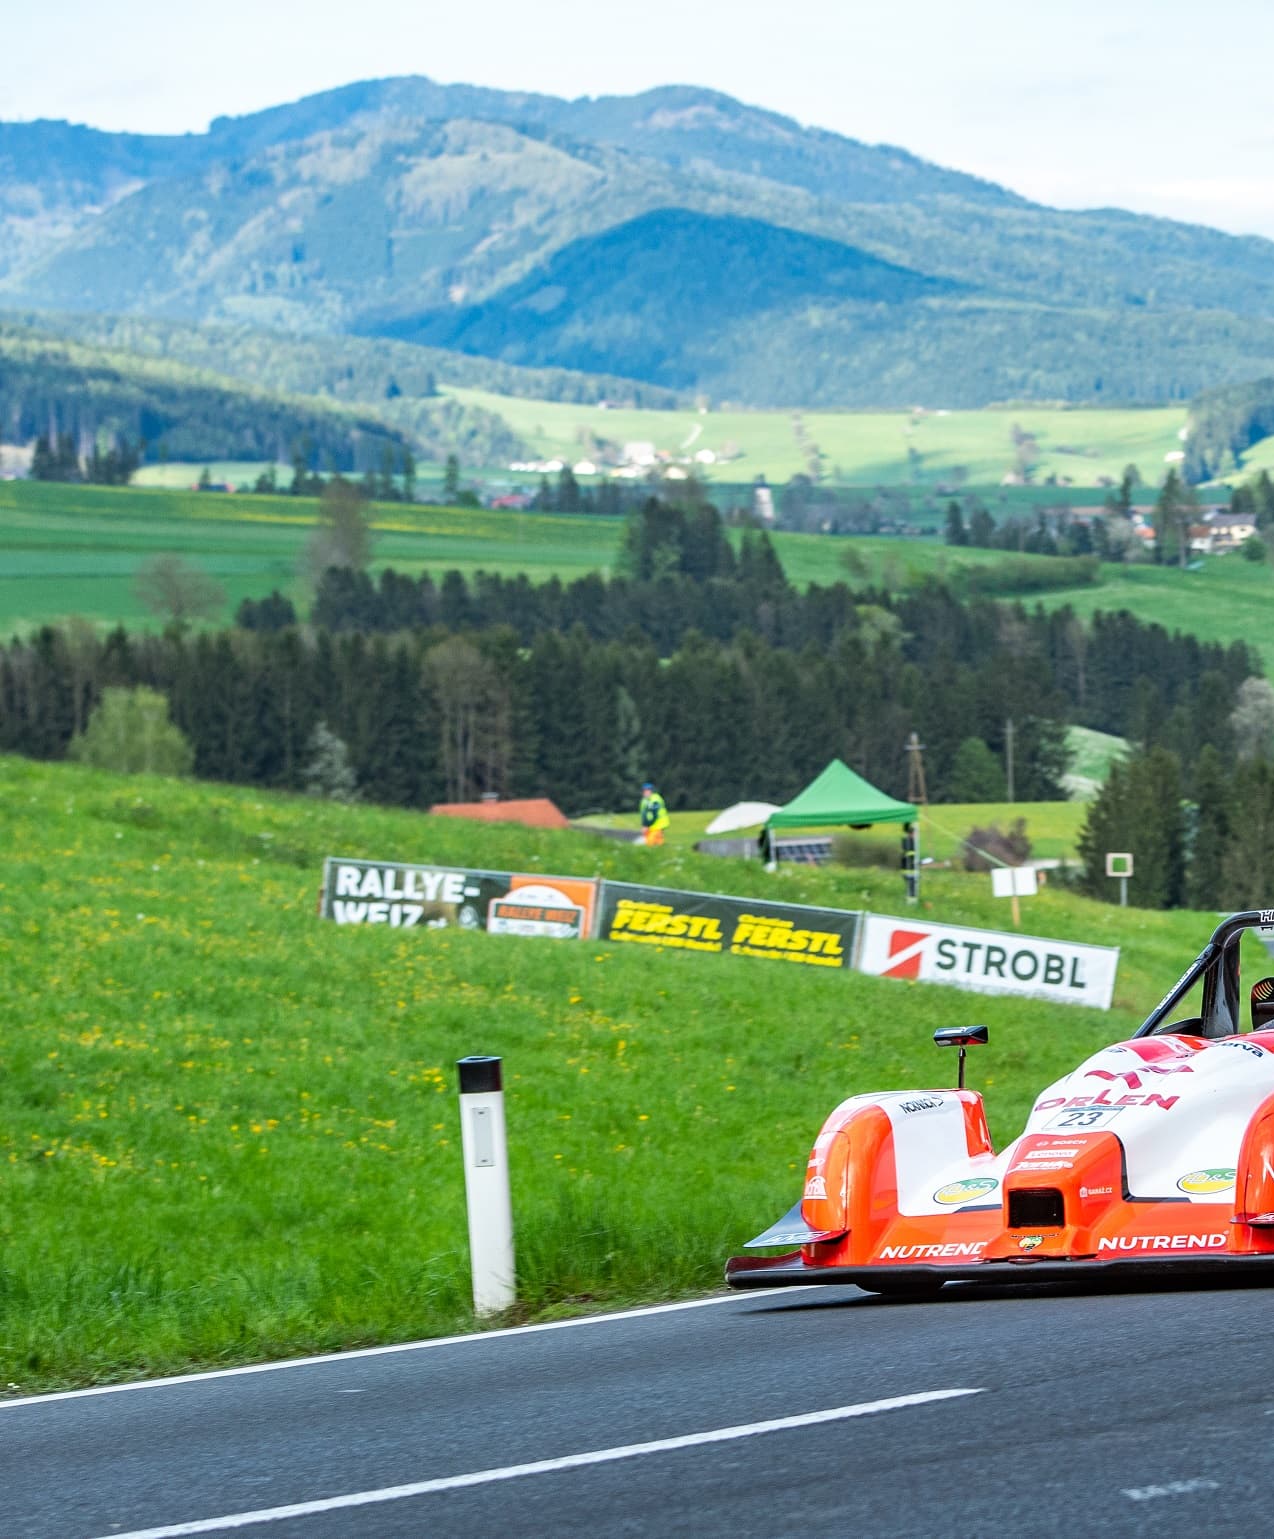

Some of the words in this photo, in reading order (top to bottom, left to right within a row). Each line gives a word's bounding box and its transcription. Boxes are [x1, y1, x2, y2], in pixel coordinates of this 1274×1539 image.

[336, 866, 480, 904] RALLYE-
[612, 909, 724, 940] FERSTL
[732, 924, 844, 955] FERSTL
[936, 938, 1087, 989] STROBL
[1034, 1089, 1181, 1112] ORLEN
[1057, 1111, 1104, 1127] 23
[1098, 1233, 1227, 1250] NUTREND
